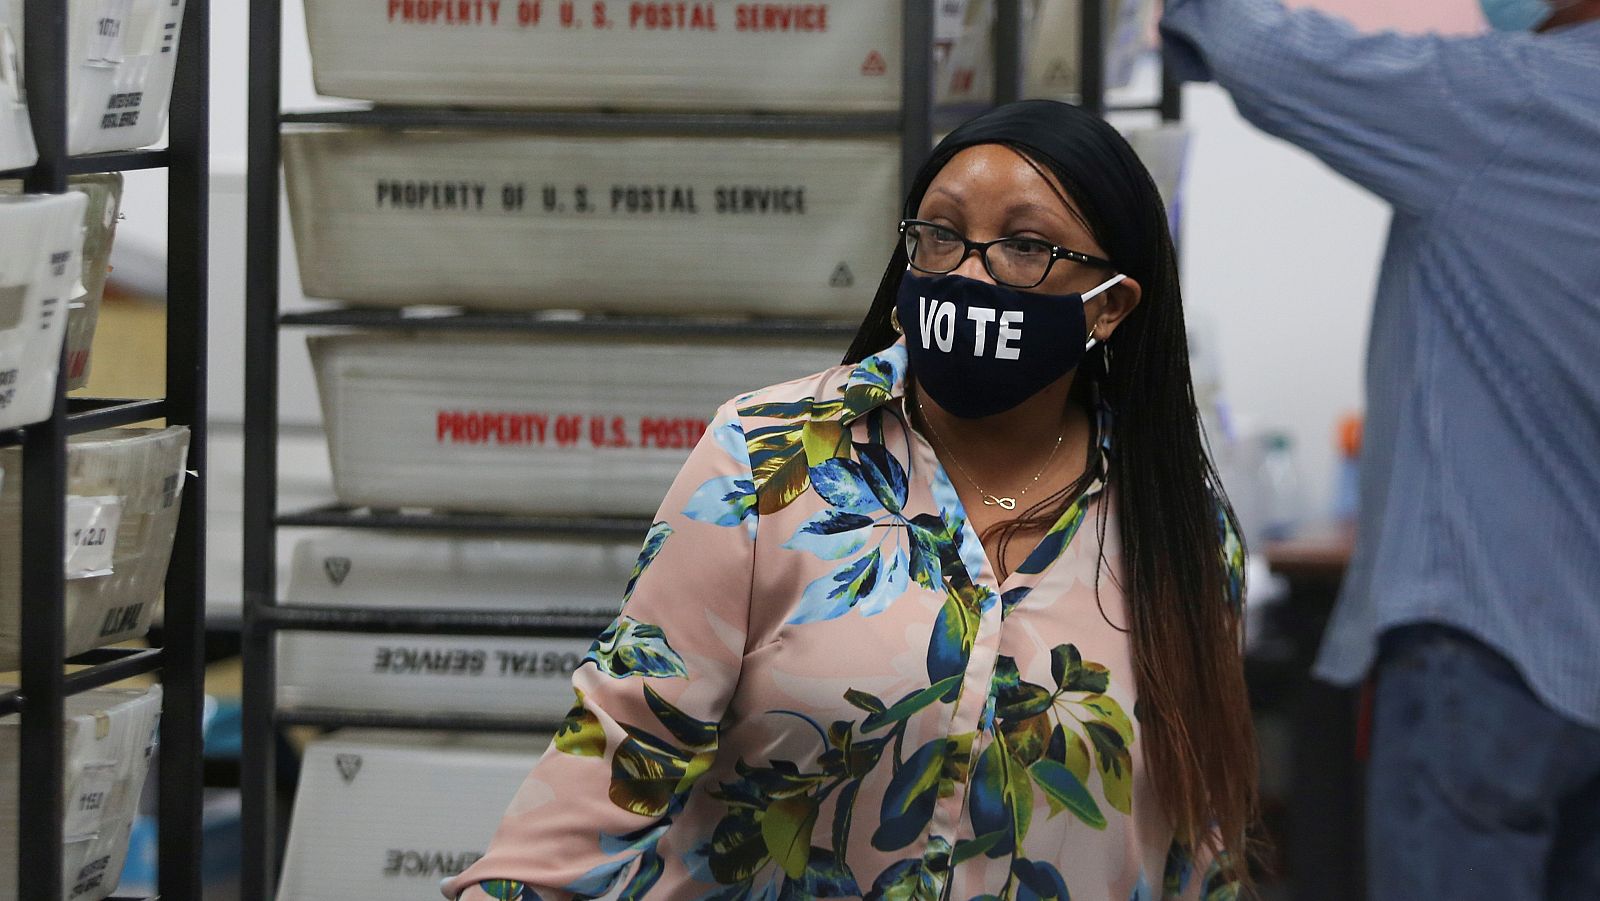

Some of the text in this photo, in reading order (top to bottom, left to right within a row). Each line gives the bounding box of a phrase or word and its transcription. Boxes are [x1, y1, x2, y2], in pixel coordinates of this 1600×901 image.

[388, 0, 499, 23] PROPERTY
[517, 0, 542, 25] OF
[629, 2, 717, 30] POSTAL
[736, 4, 828, 33] SERVICE
[376, 180, 486, 211] PROPERTY
[501, 182, 526, 211] OF
[610, 185, 698, 214] POSTAL
[713, 186, 806, 215] SERVICE
[436, 411, 711, 449] PROPERTY OF U.S. POSTA
[374, 647, 581, 678] OSTAL SERVICE
[383, 850, 485, 878] RVICE
